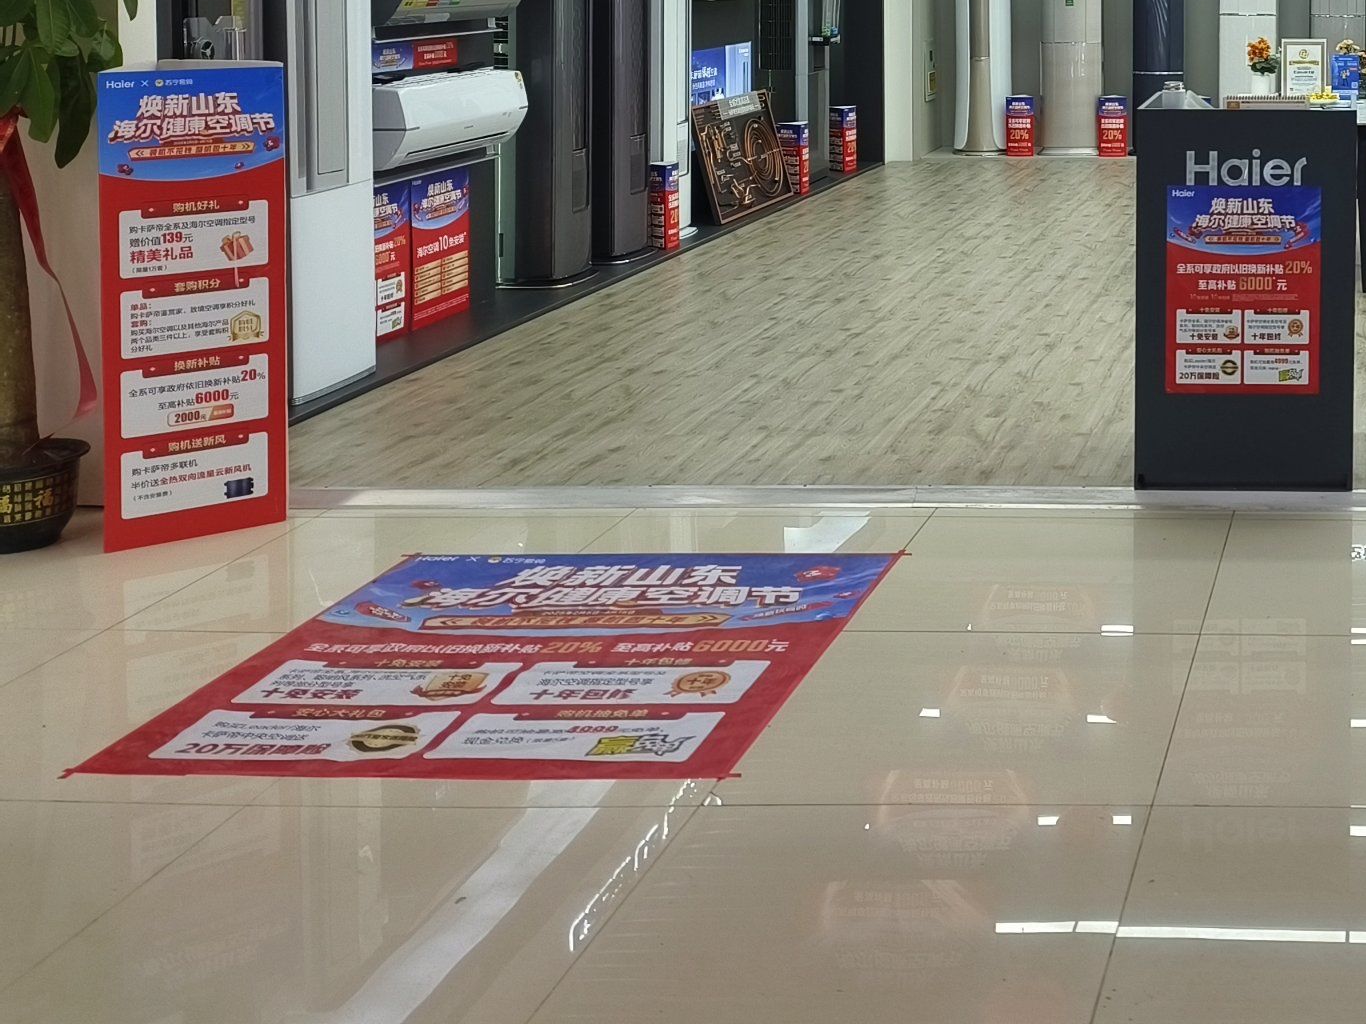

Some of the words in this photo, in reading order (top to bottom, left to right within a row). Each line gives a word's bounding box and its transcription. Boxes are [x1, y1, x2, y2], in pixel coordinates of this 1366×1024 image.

[106, 79, 135, 89] Haier
[137, 91, 242, 117] 焕新山东
[109, 112, 275, 142] 海尔健康空调节
[1186, 148, 1307, 187] Haier
[373, 192, 389, 207] 山东
[1171, 189, 1195, 198] Haier
[173, 200, 220, 213] 购机好礼
[1209, 197, 1275, 214] 焕新山东
[1191, 214, 1296, 229] 海尔健康空调节
[129, 232, 194, 248] 赠价值139元
[129, 245, 194, 264] 精美礼品
[174, 278, 221, 293] 套购积分
[174, 356, 221, 372] 换新补贴
[157, 388, 240, 411] 至高补贴6000元
[168, 434, 227, 452] 购机送新风
[131, 459, 198, 476] 购卡萨帝多联机
[495, 565, 742, 587] 焕新山东
[412, 586, 803, 608] 海尔健康空调节
[260, 688, 364, 701] 十免安装
[528, 688, 638, 701] 十年包修
